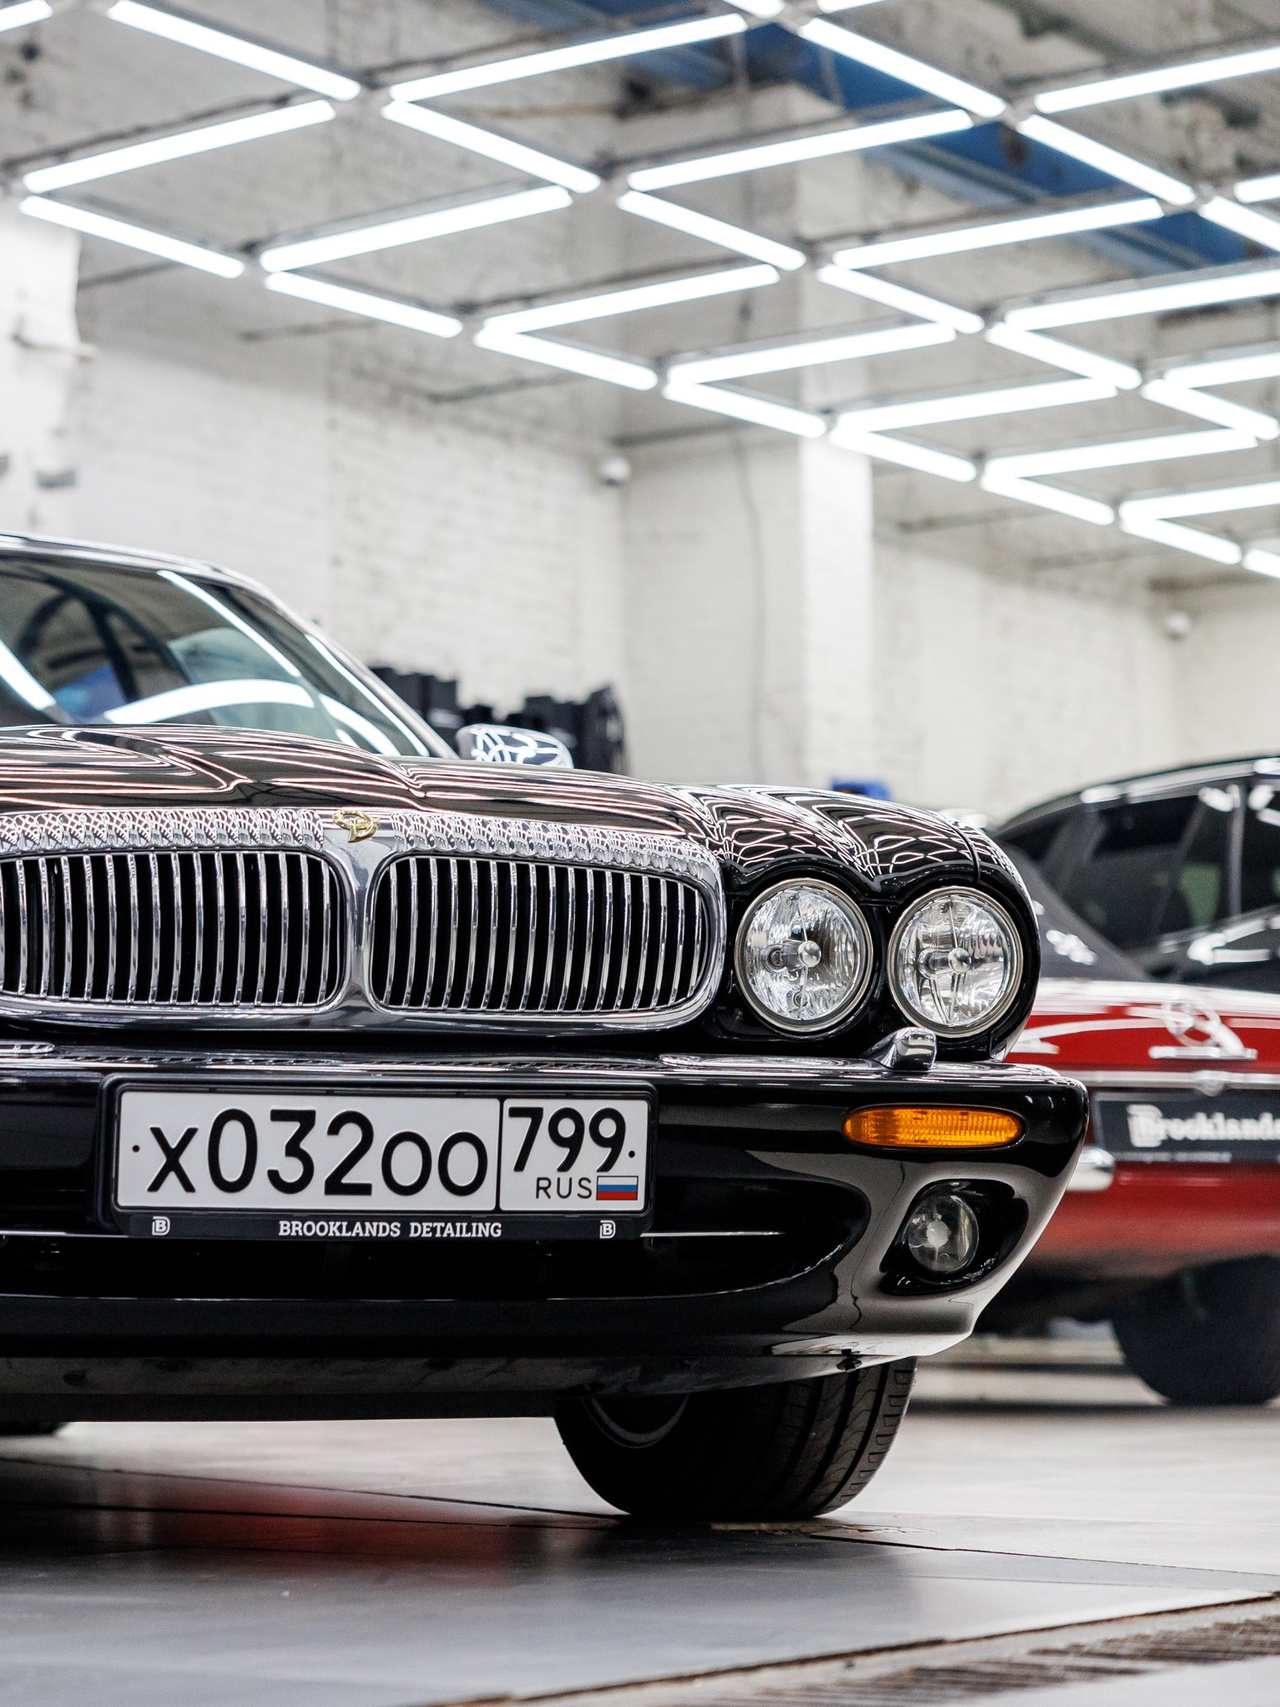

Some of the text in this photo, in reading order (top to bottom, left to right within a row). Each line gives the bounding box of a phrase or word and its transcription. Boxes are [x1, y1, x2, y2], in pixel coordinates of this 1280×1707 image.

[508, 1106, 627, 1173] 799
[535, 1176, 593, 1200] RUS
[278, 1220, 502, 1238] BROOKLANDS DETAILING
